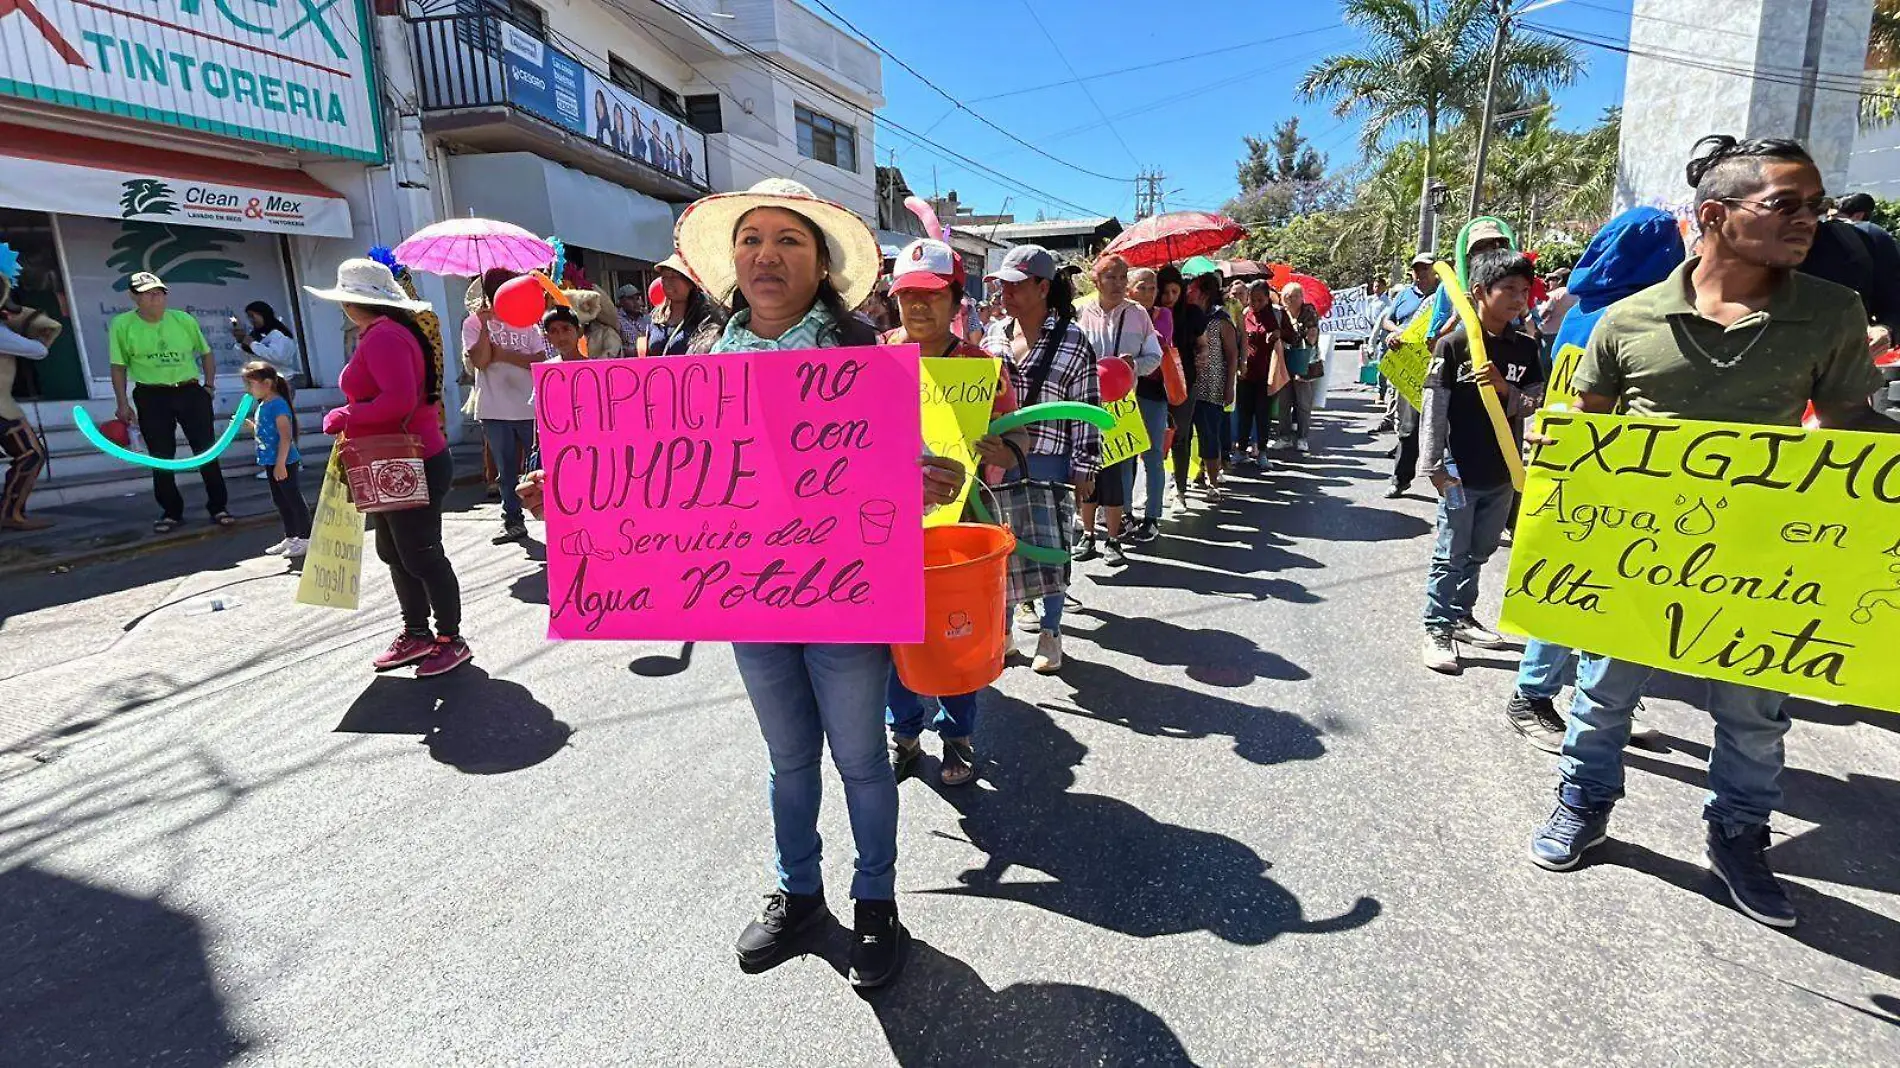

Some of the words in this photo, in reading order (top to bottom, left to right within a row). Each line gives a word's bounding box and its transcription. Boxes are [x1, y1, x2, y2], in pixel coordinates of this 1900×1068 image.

[82, 30, 347, 127] TINTORERIA
[186, 187, 239, 208] Clean
[245, 198, 263, 219] &
[266, 195, 302, 213] Mex
[538, 361, 750, 434] CAPACH
[796, 359, 869, 402] no
[551, 436, 760, 516] CUMPLE
[790, 416, 875, 453] con
[794, 456, 849, 498] el
[618, 518, 752, 557] Servicio
[765, 515, 838, 548] del
[1780, 521, 1849, 549] en
[550, 555, 655, 632] Agua
[1616, 538, 1825, 607] Colonia
[1664, 602, 1857, 687] Vista
